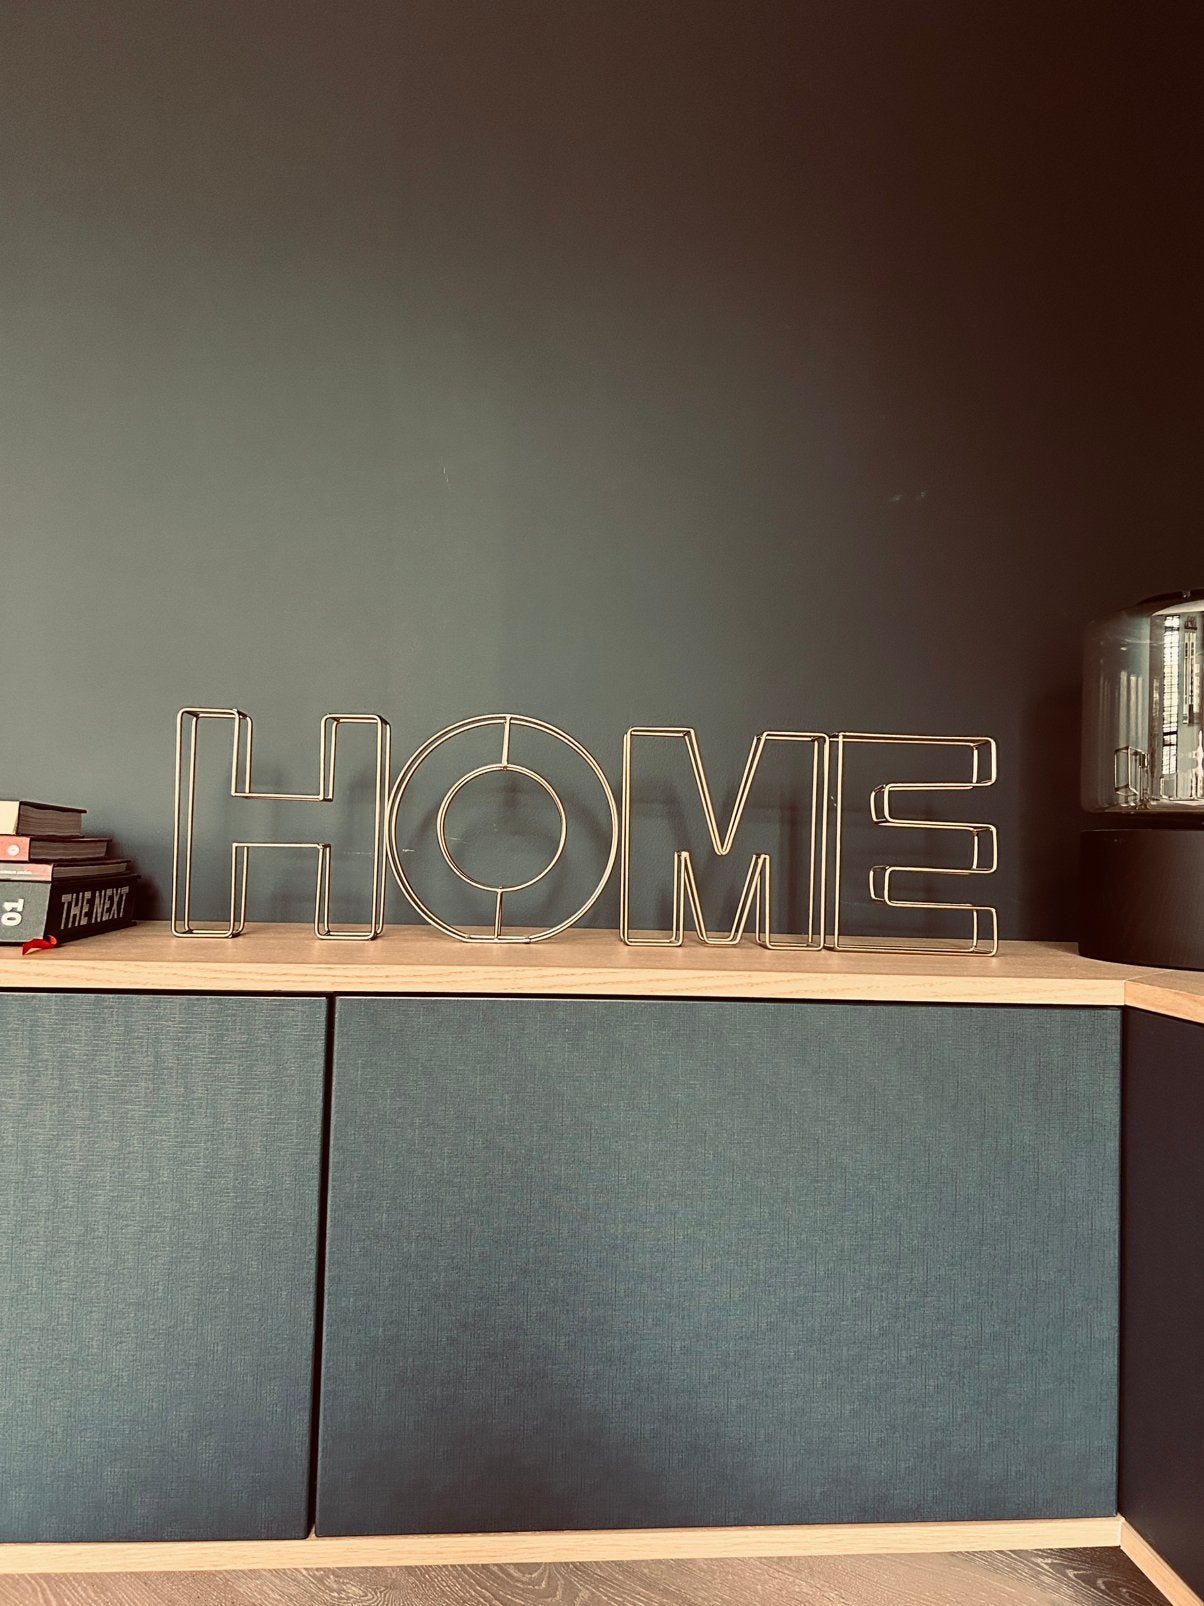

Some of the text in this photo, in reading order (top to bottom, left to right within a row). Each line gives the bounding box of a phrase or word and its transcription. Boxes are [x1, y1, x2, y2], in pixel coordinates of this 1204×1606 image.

[171, 707, 998, 957] HOME
[60, 886, 130, 930] THE NEXT
